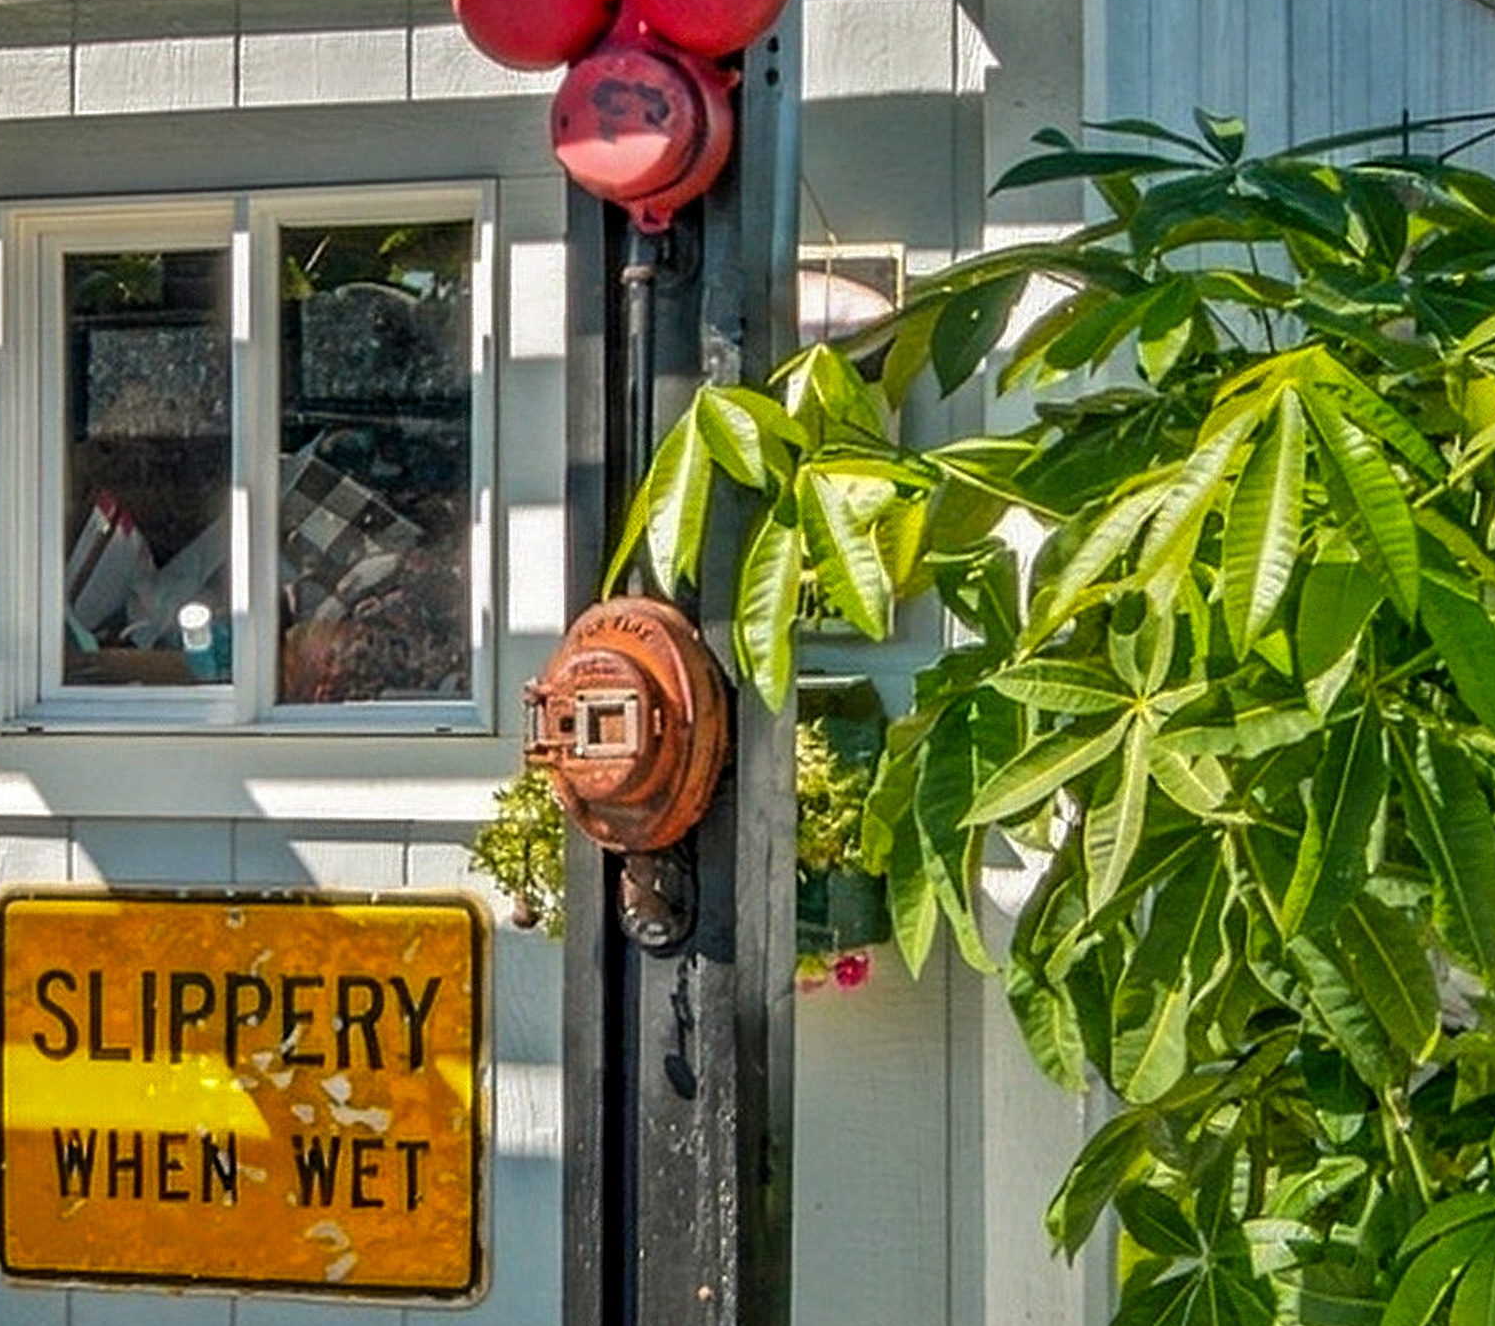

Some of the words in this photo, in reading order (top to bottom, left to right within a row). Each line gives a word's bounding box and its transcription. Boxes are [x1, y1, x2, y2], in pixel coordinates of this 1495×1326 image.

[33, 969, 442, 1070] SLIPPERY
[53, 1128, 238, 1203] WHEN
[291, 1135, 430, 1211] WET
